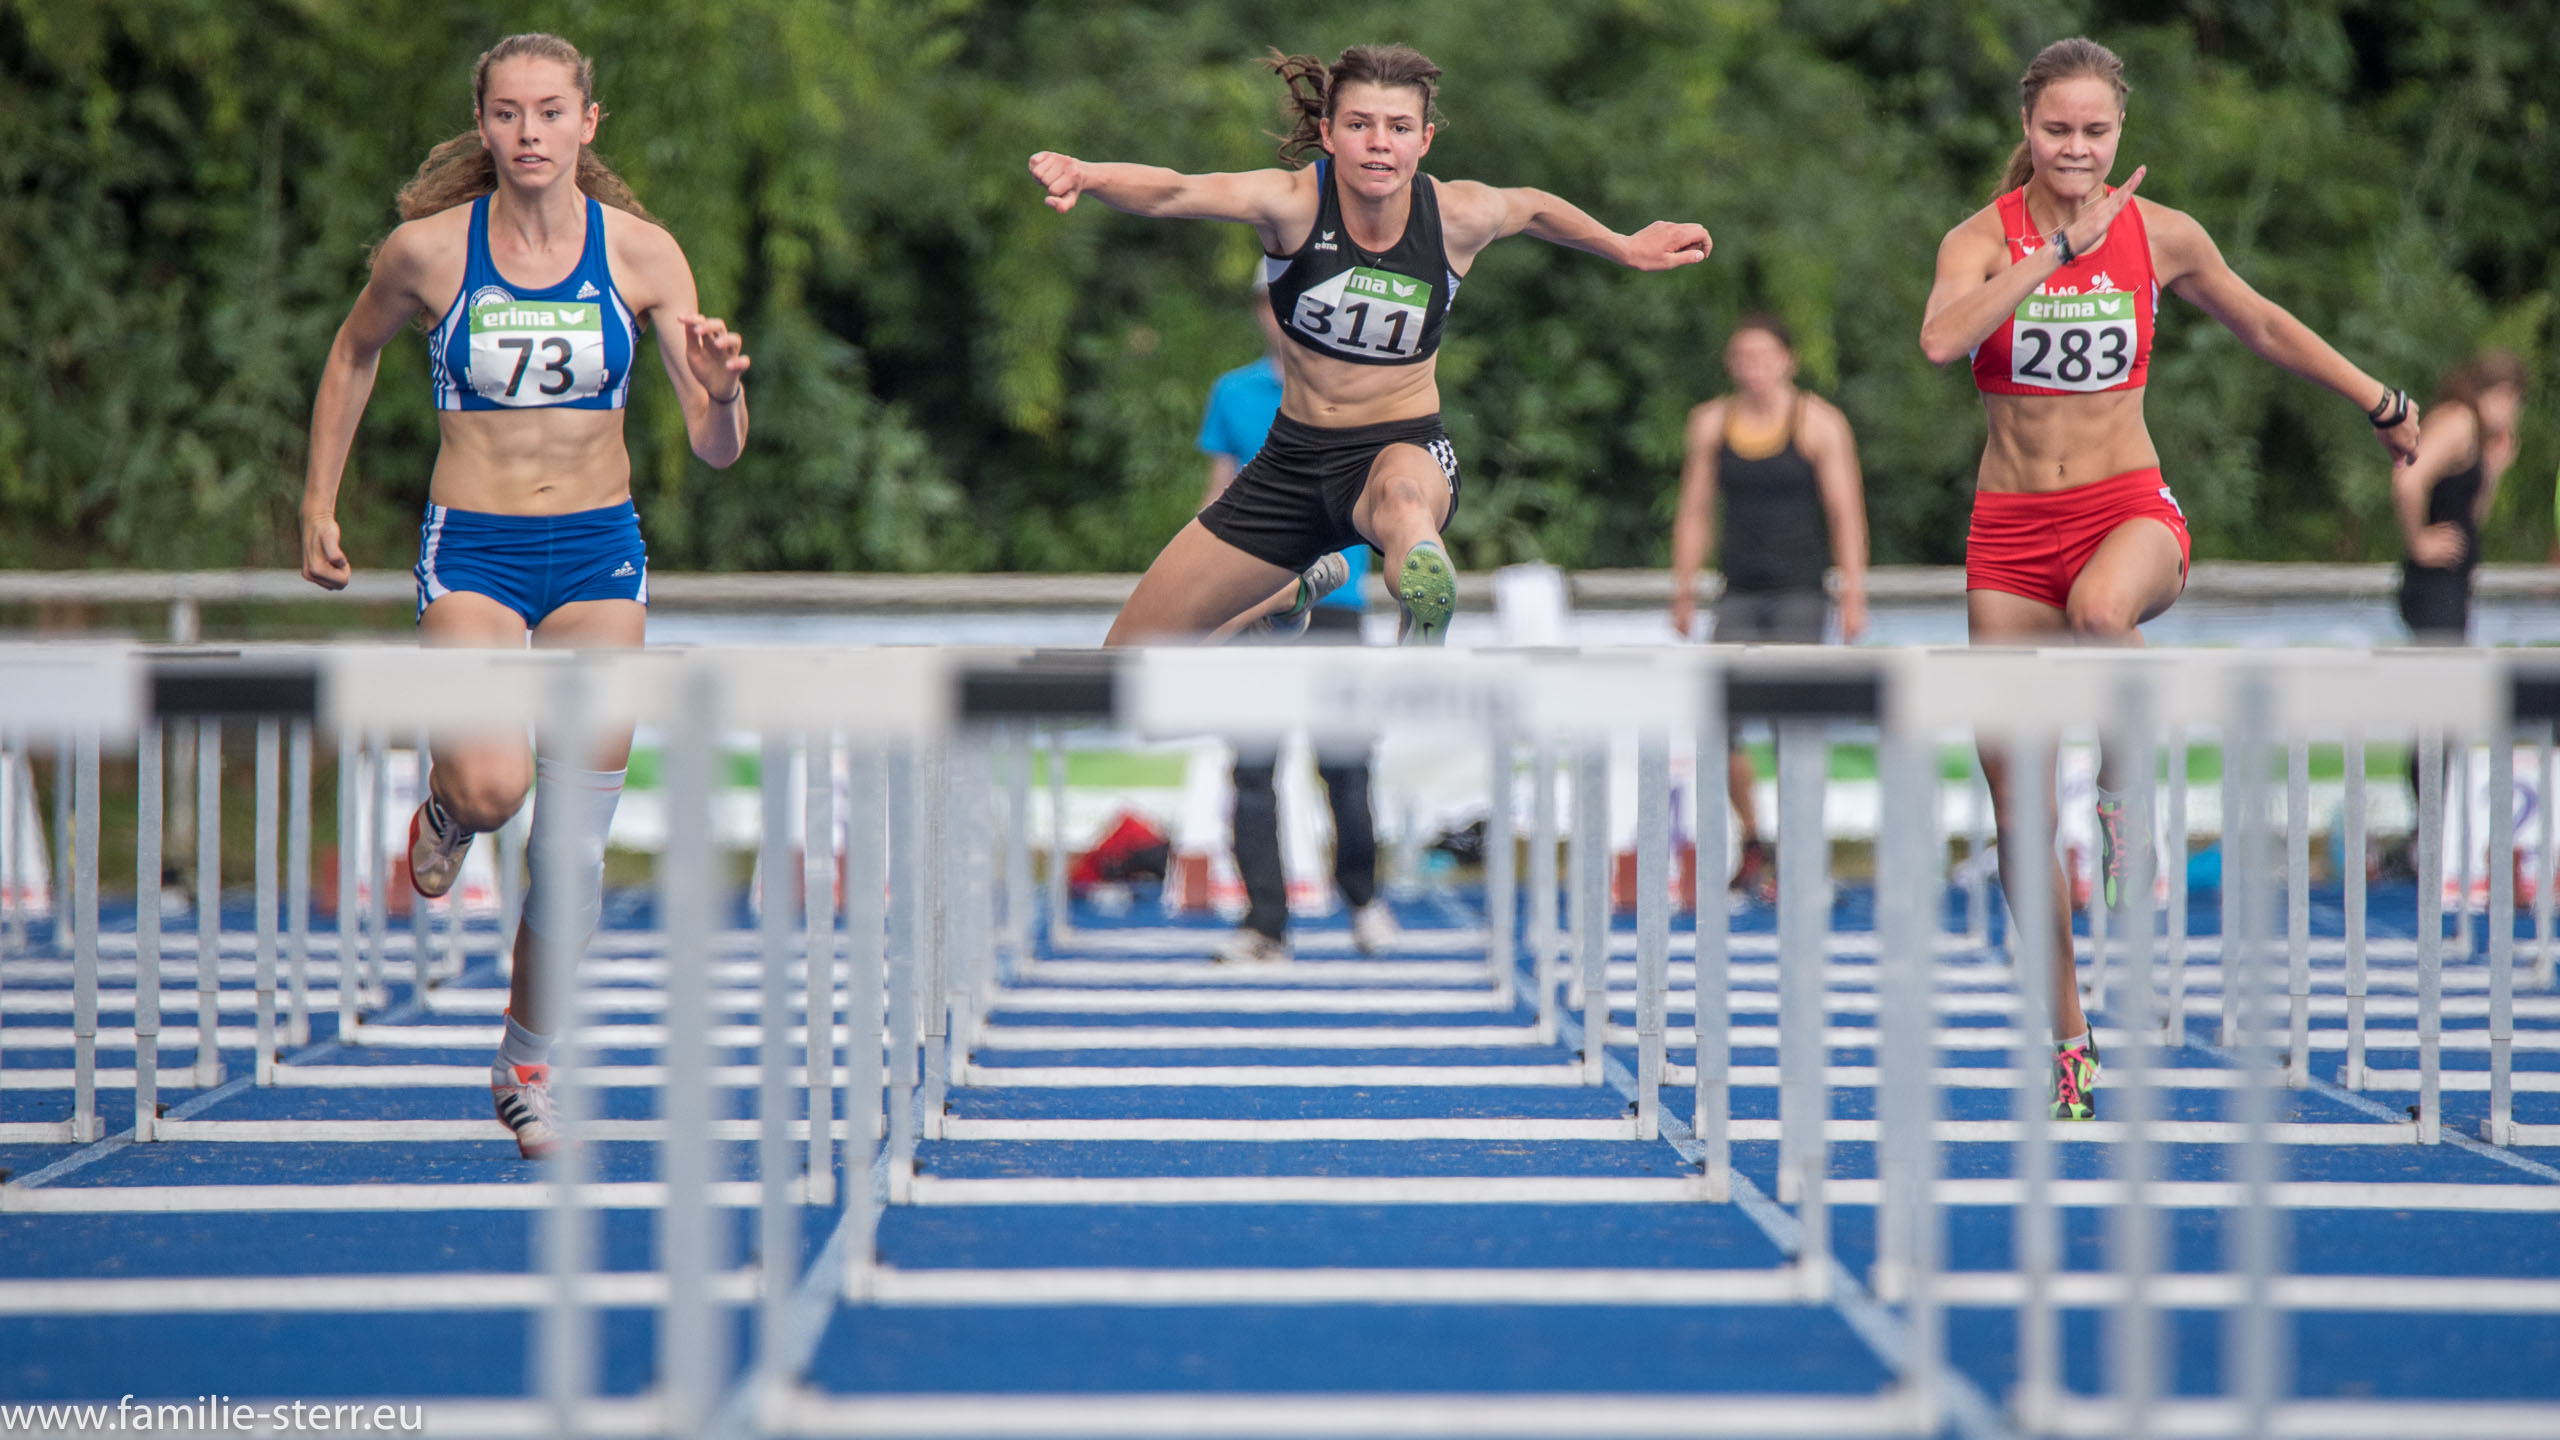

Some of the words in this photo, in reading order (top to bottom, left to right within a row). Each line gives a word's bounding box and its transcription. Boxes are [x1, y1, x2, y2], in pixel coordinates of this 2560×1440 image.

[482, 306, 556, 328] erima
[1300, 297, 1408, 355] 311
[2028, 299, 2096, 319] erima
[498, 336, 575, 397] 73
[2018, 326, 2128, 382] 283
